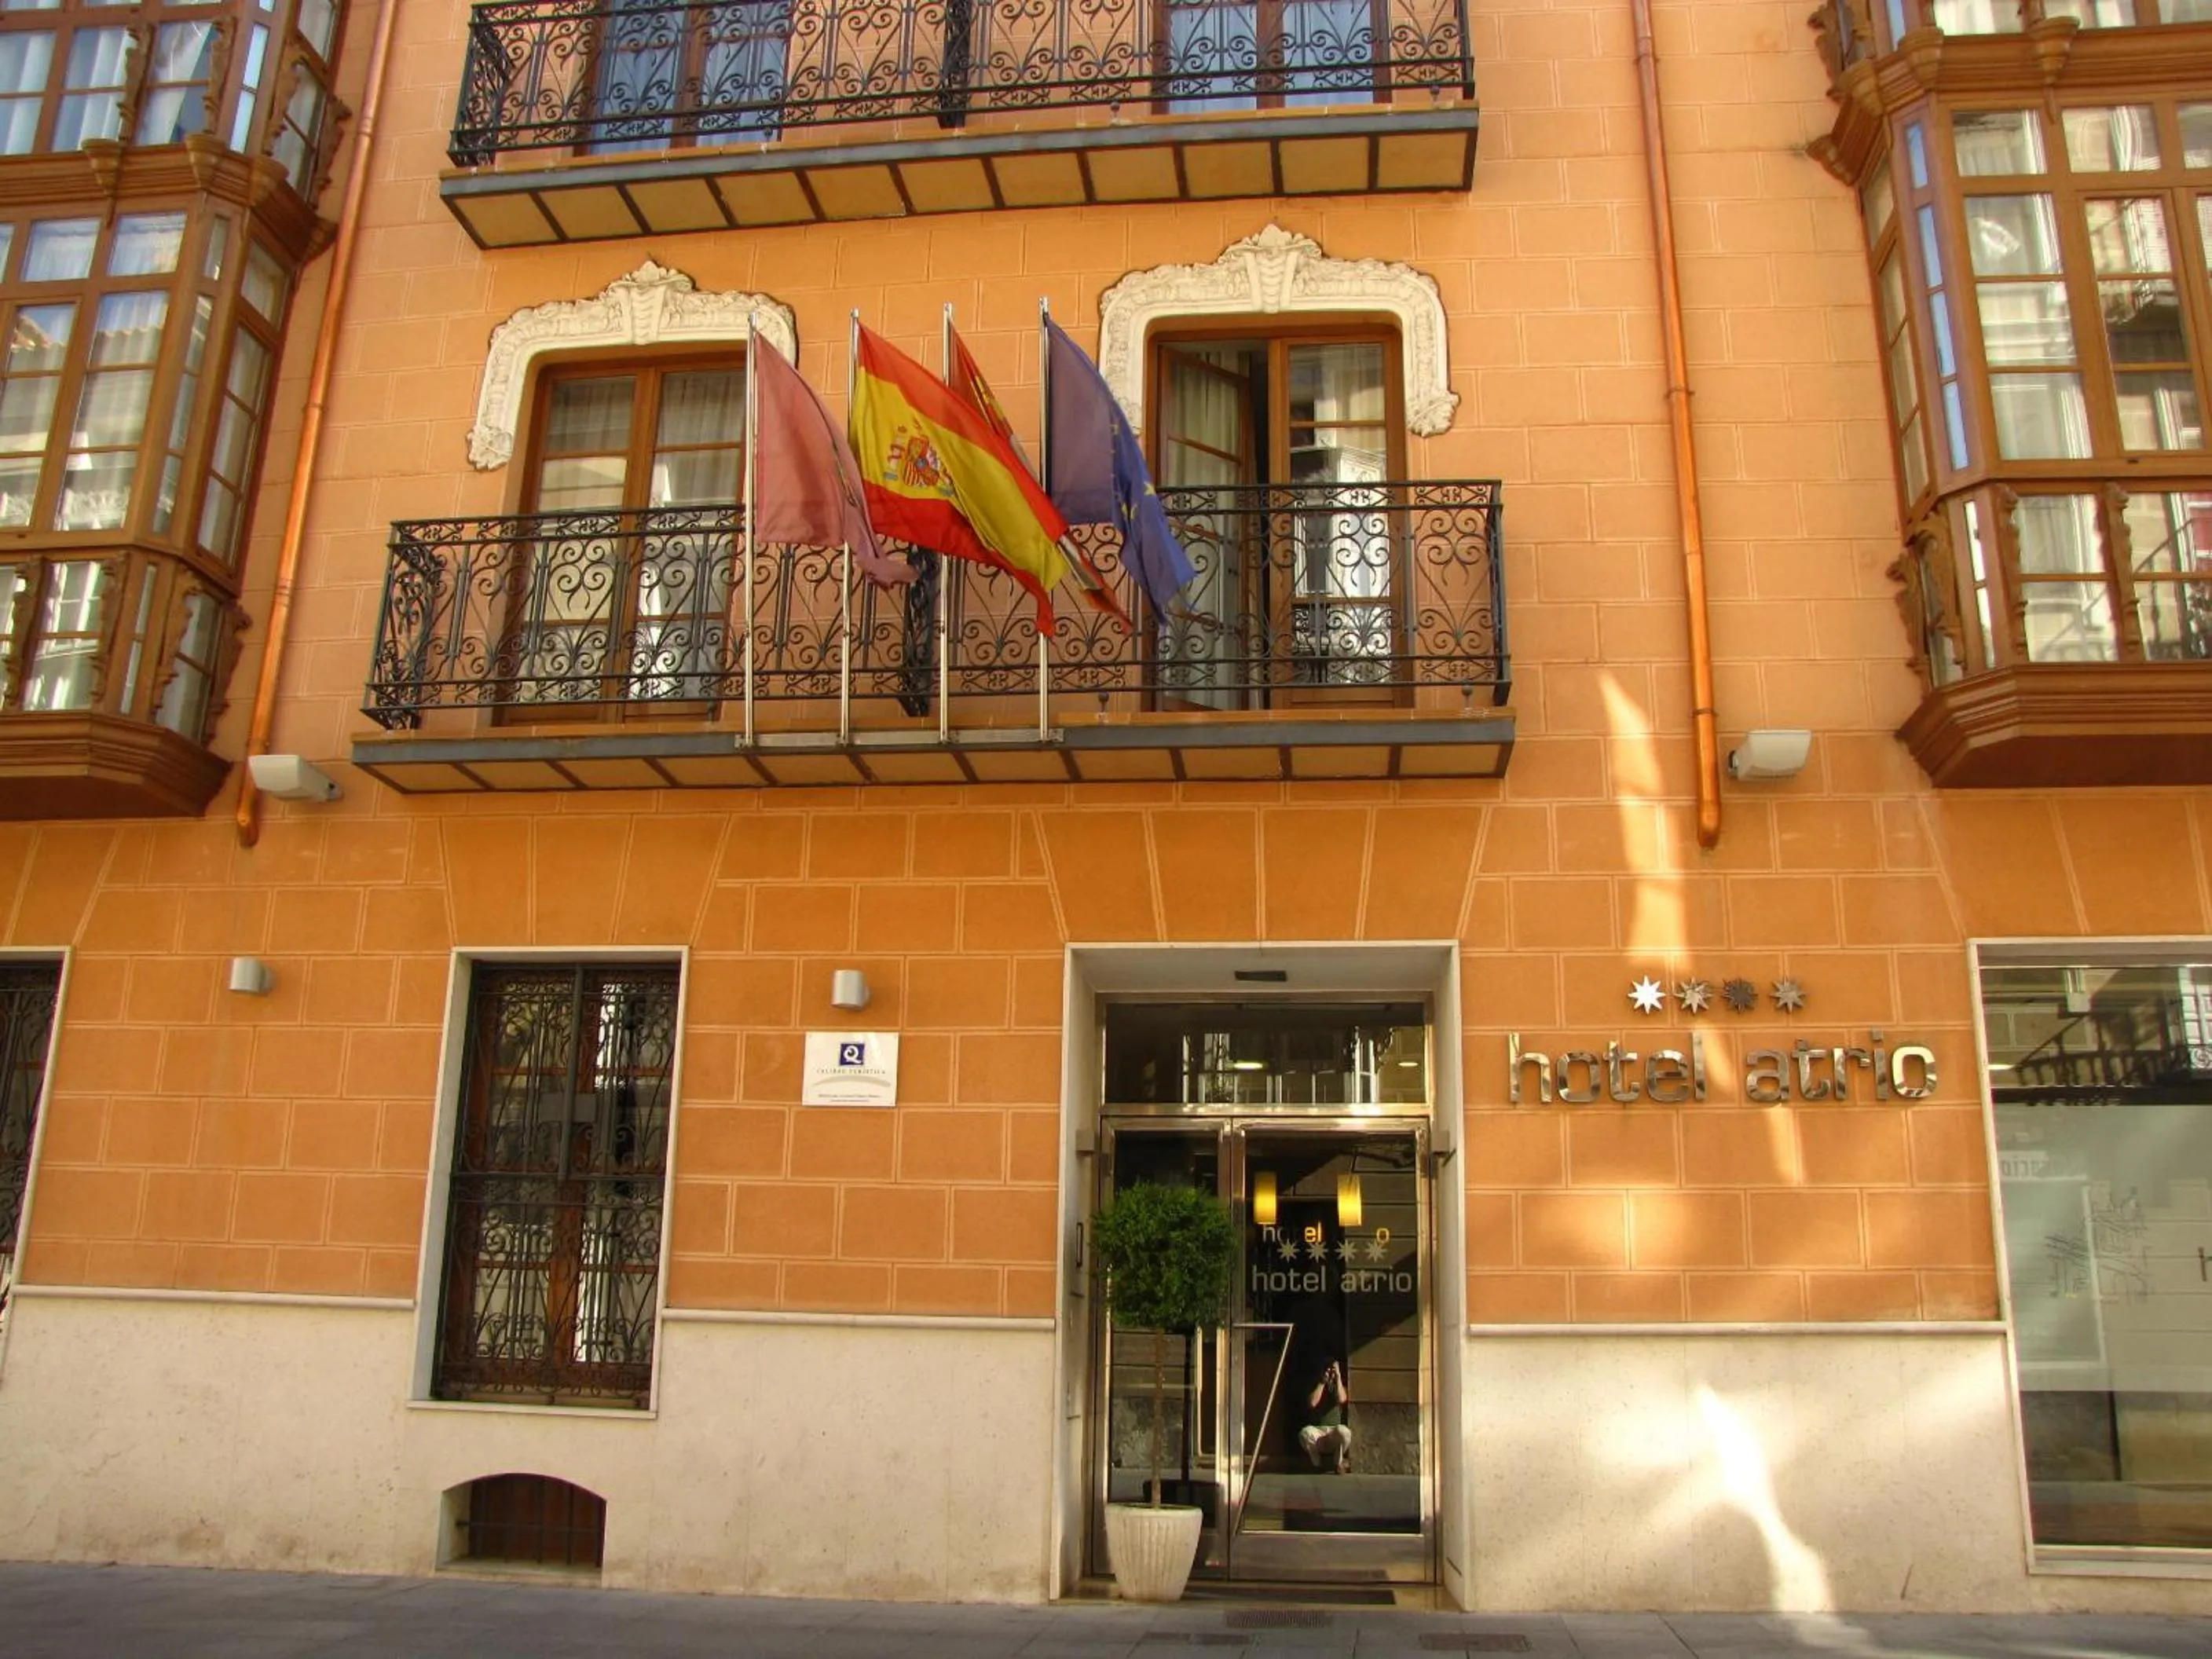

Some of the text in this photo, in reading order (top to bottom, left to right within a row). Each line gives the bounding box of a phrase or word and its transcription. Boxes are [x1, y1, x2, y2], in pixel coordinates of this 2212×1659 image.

[843, 1045, 862, 1064] Q
[1508, 1027, 1939, 1104] hotel atrio
[1251, 1265, 1412, 1293] hotel atrio
